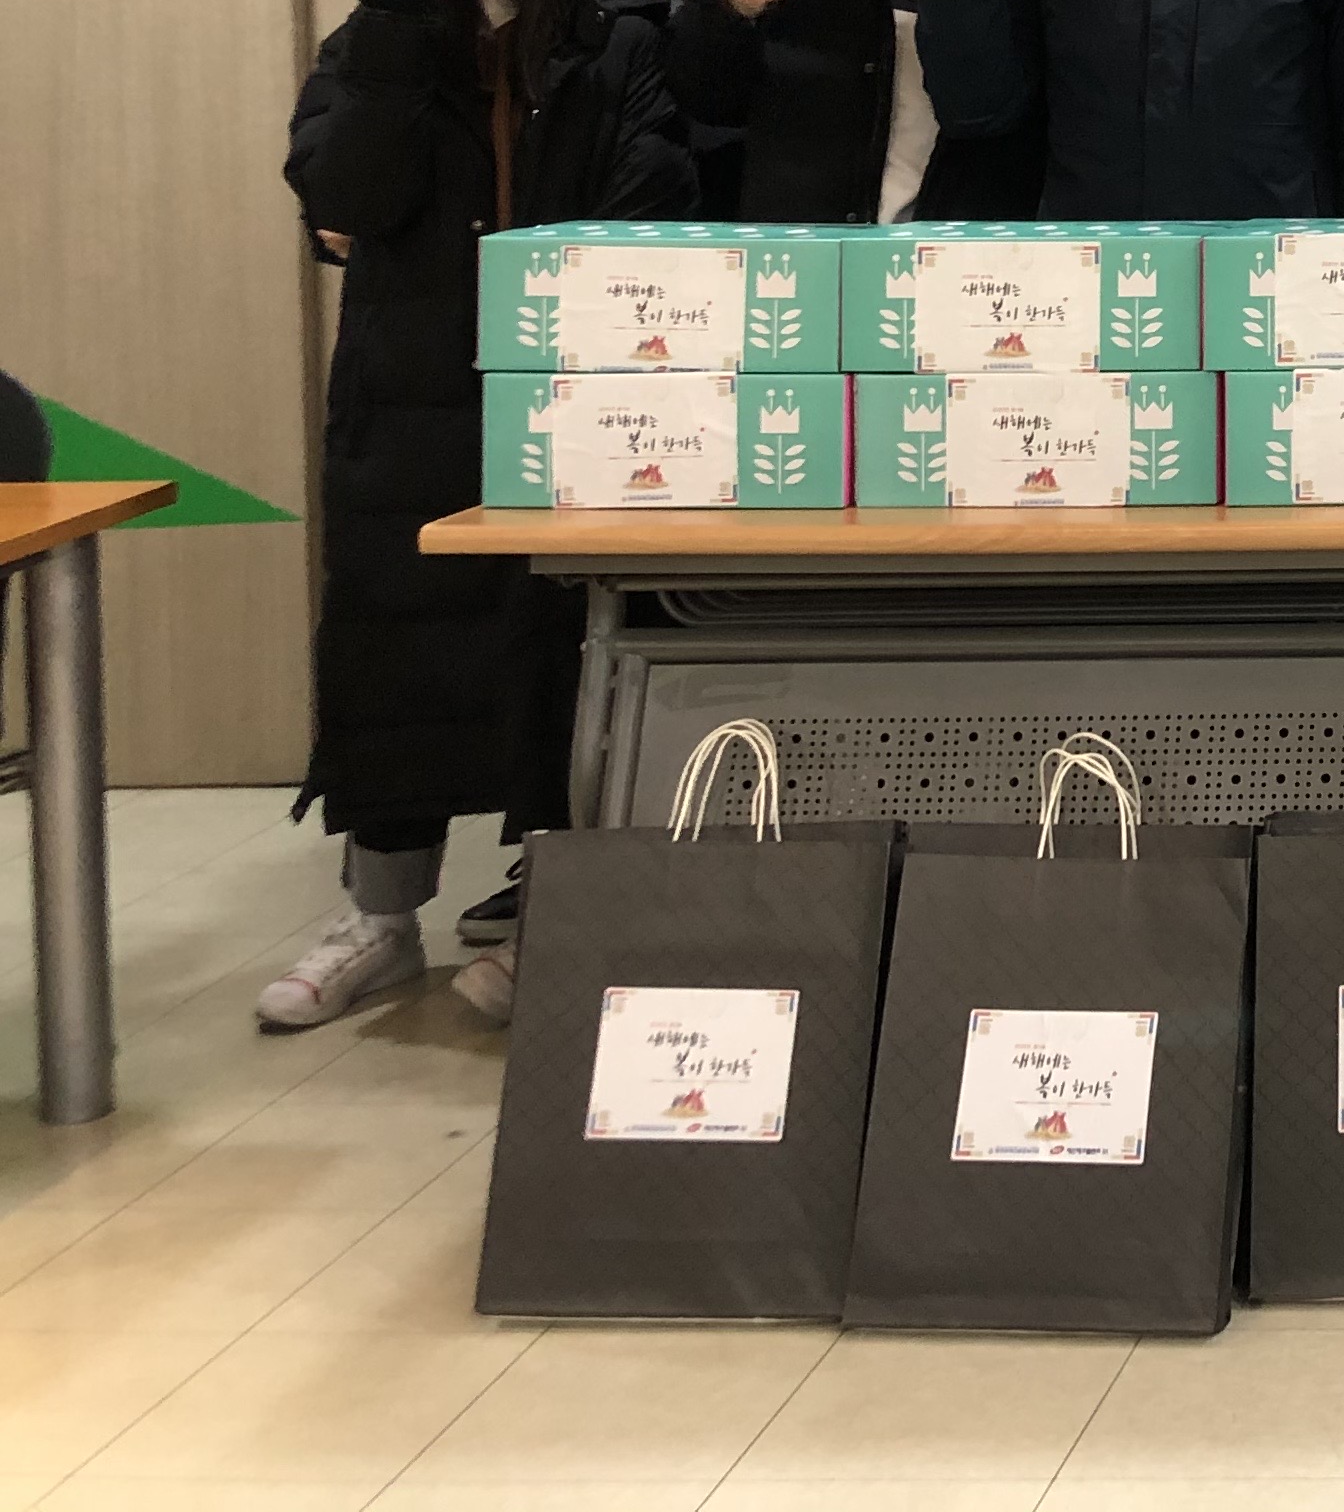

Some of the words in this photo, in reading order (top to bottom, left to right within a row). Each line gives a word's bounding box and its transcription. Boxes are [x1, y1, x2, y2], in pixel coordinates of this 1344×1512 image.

[961, 281, 1021, 298] 새해에는
[992, 414, 1053, 431] 새해에는
[1012, 1051, 1072, 1070] 새해에는
